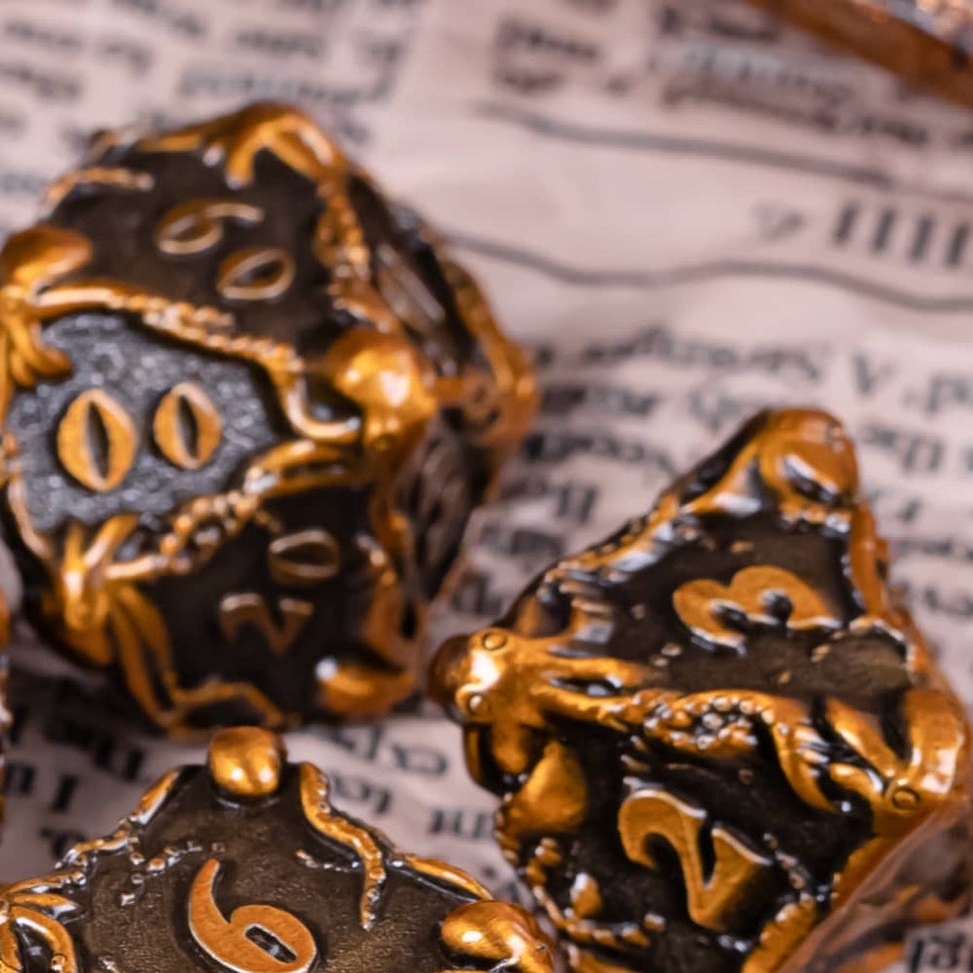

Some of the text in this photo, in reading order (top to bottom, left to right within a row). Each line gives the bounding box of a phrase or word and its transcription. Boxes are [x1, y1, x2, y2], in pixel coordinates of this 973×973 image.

[56, 381, 223, 493] 00
[671, 562, 845, 660] 3
[617, 786, 775, 928] 2
